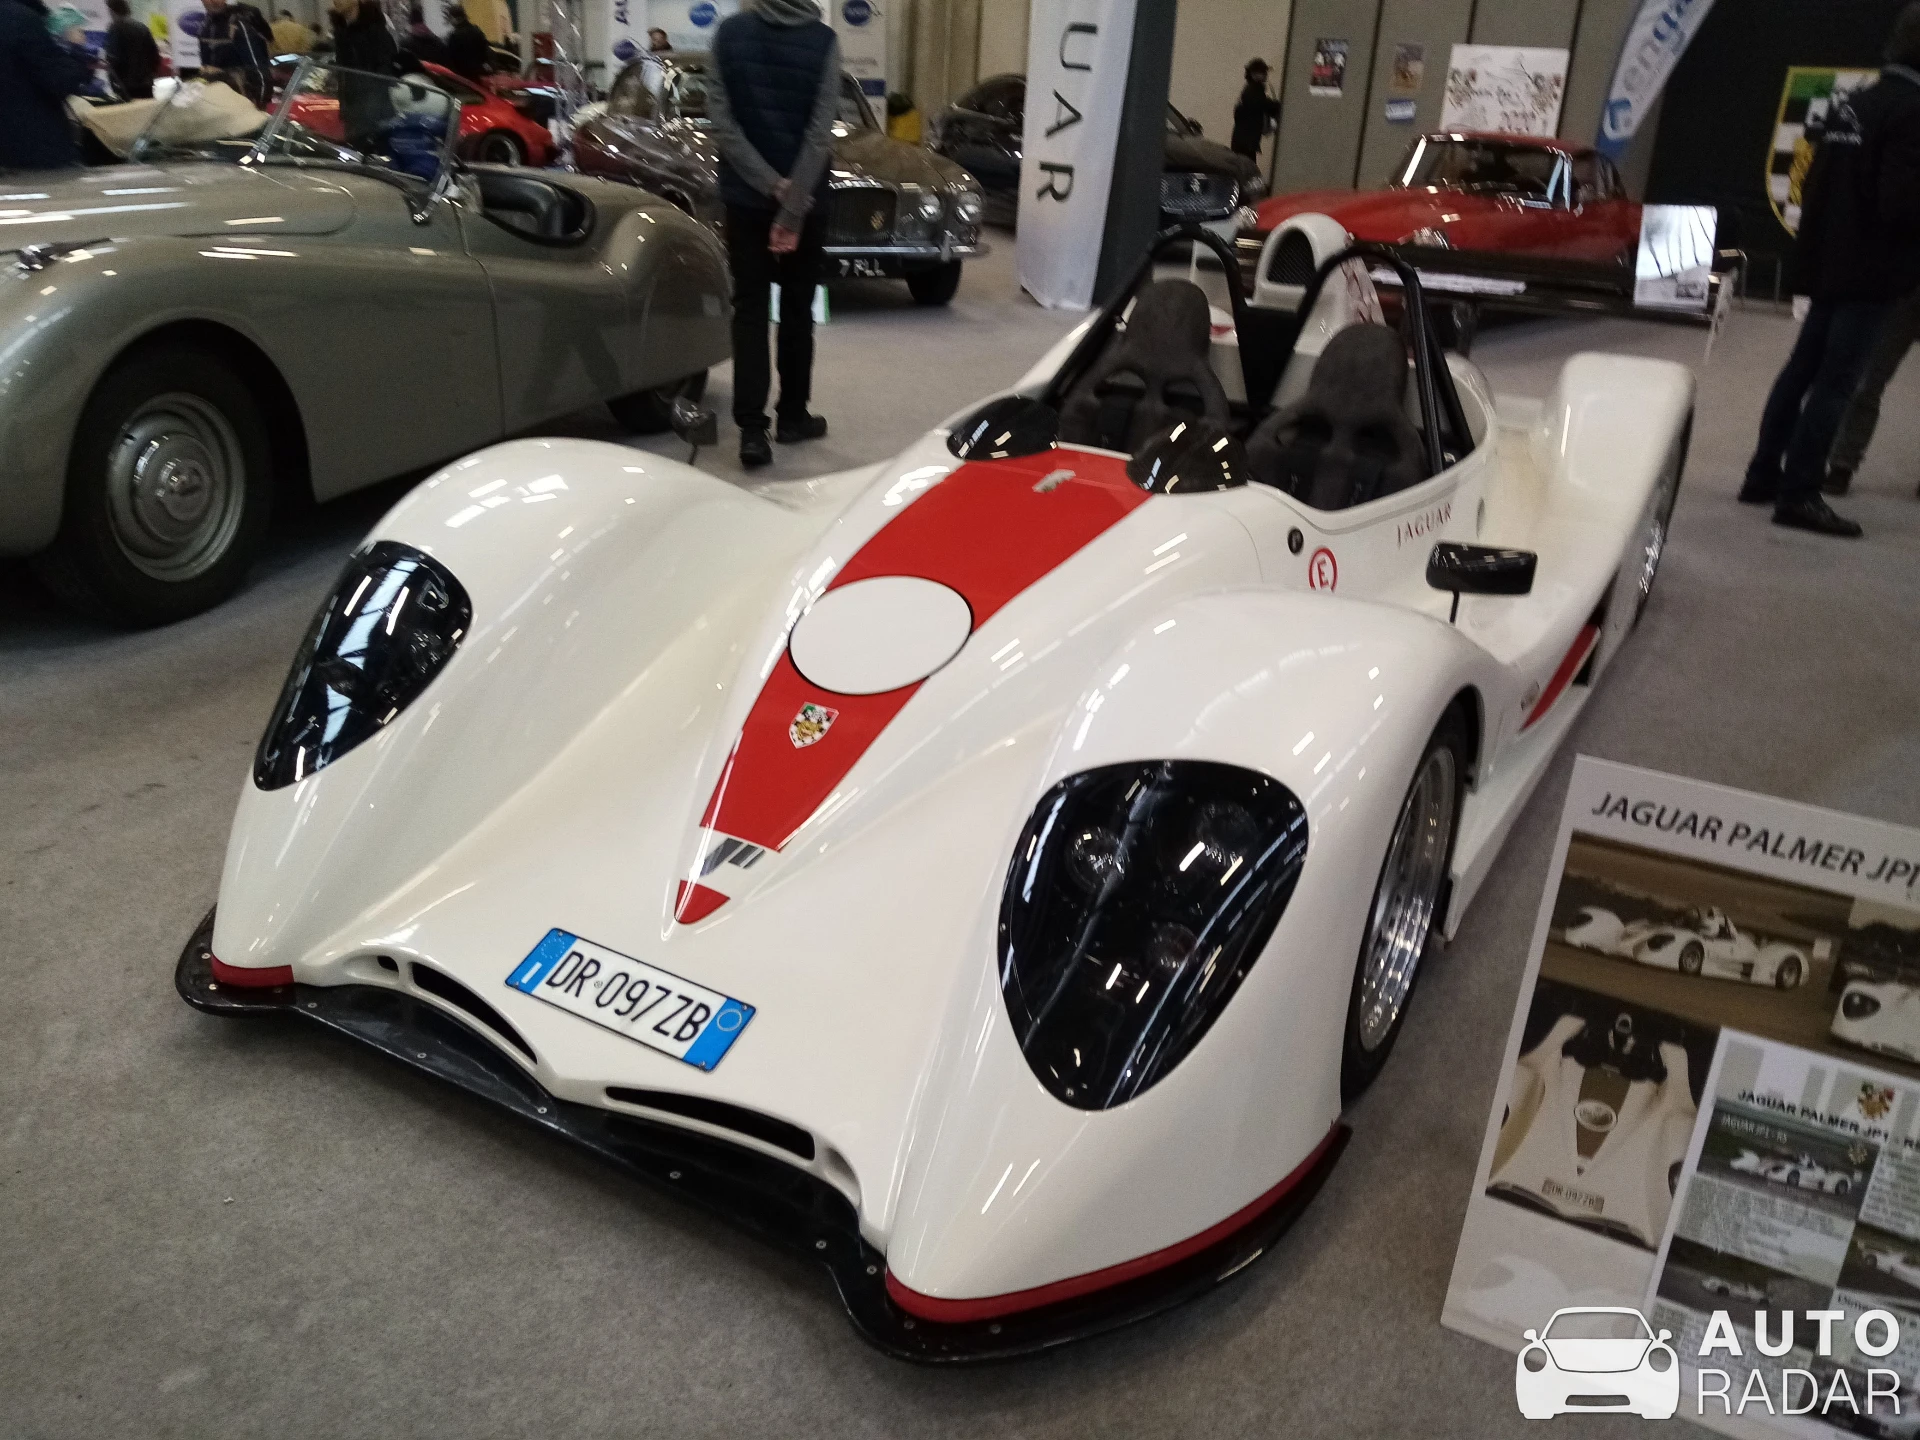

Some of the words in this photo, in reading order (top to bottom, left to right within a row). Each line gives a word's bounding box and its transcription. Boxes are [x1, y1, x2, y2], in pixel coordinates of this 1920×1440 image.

[1397, 503, 1452, 547] JAGUAR
[1316, 558, 1330, 589] E
[1592, 792, 1723, 843] JAGUAR
[1727, 821, 1866, 875] PALMER
[545, 950, 602, 998] DR
[1738, 1089, 1796, 1116] JAGUAR
[1801, 1106, 1860, 1134] PALMER
